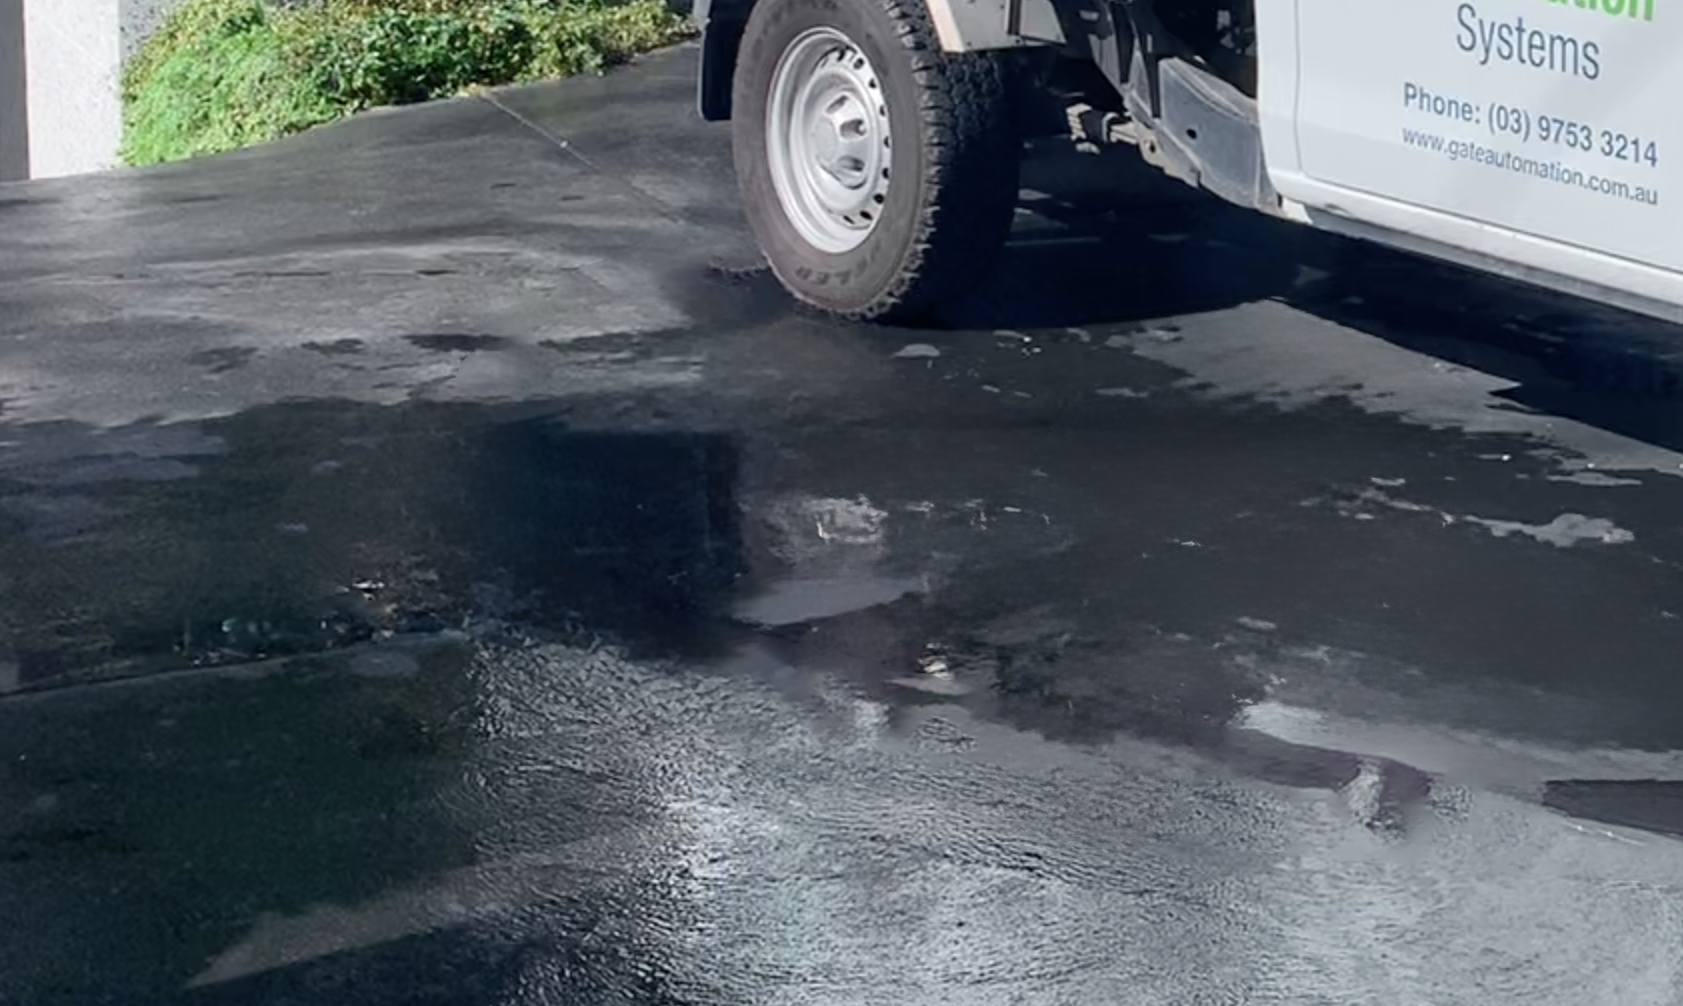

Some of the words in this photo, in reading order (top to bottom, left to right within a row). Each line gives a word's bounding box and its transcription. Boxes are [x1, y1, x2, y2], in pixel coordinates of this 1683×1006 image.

[1456, 2, 1600, 80] Systems
[1403, 81, 1481, 125] Phone:
[1487, 101, 1532, 143] (03)
[1537, 113, 1594, 154] 9753
[1600, 129, 1659, 168] 3214
[1402, 126, 1659, 207] www.gateautomation.com.au
